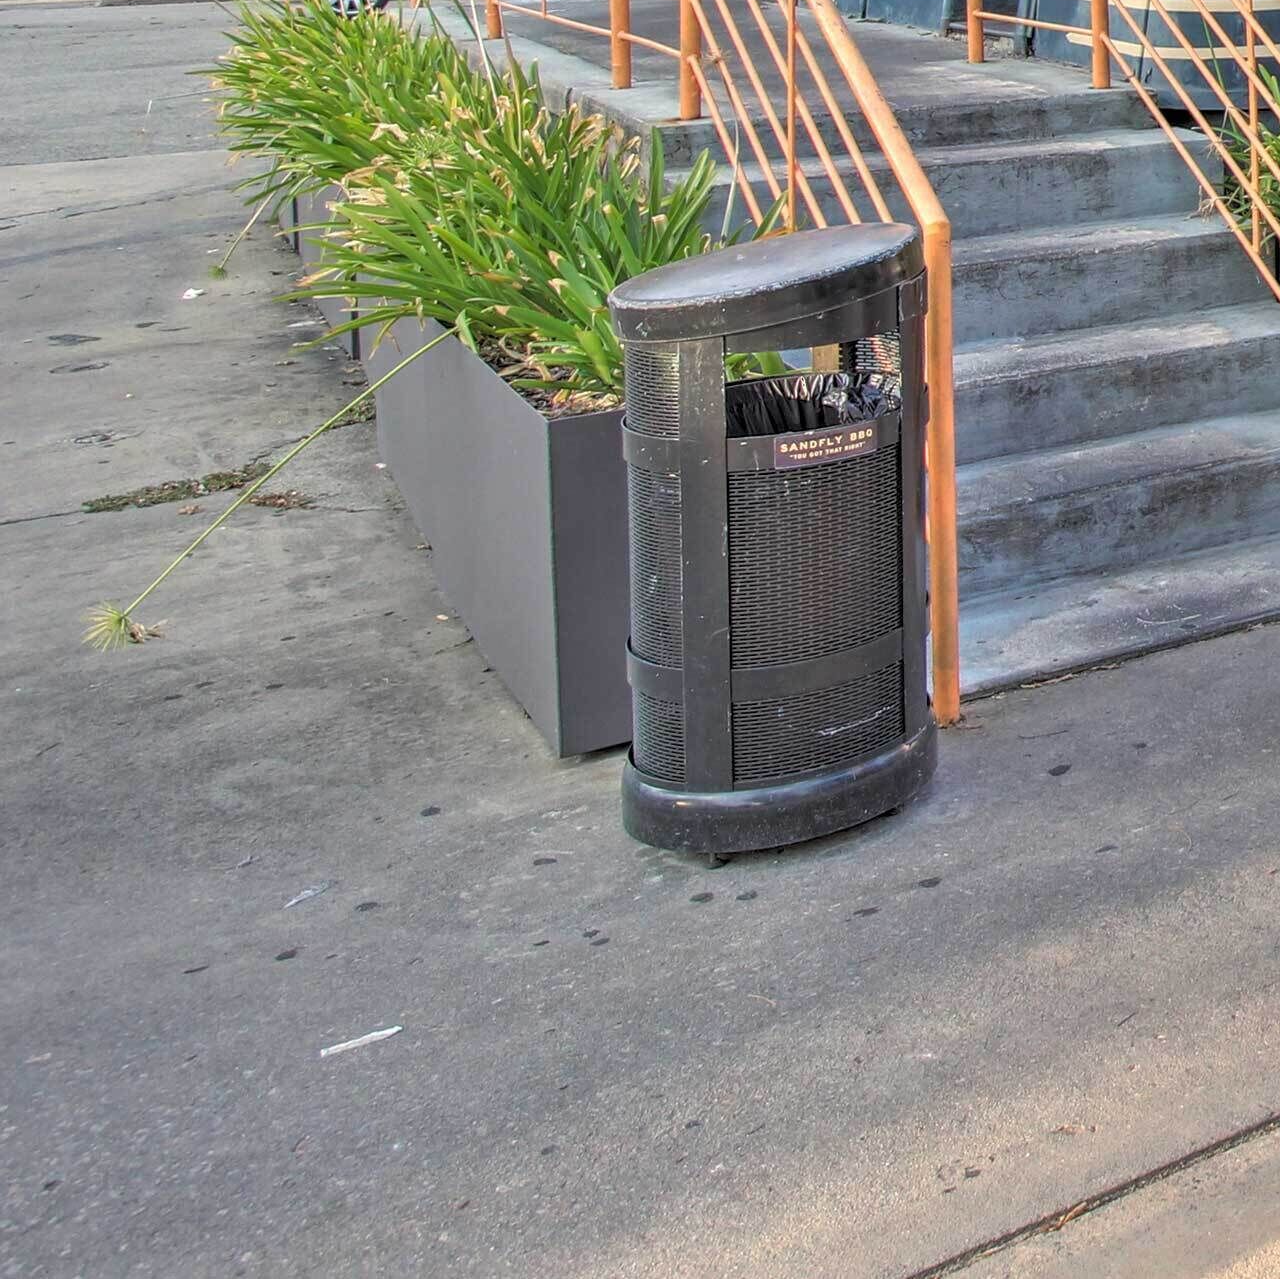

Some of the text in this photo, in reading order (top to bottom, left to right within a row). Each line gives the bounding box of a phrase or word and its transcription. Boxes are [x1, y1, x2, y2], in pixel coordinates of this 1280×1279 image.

[780, 428, 873, 453] SANDFLY BBQ
[809, 450, 823, 458] GOT
[825, 446, 842, 455] THAT
